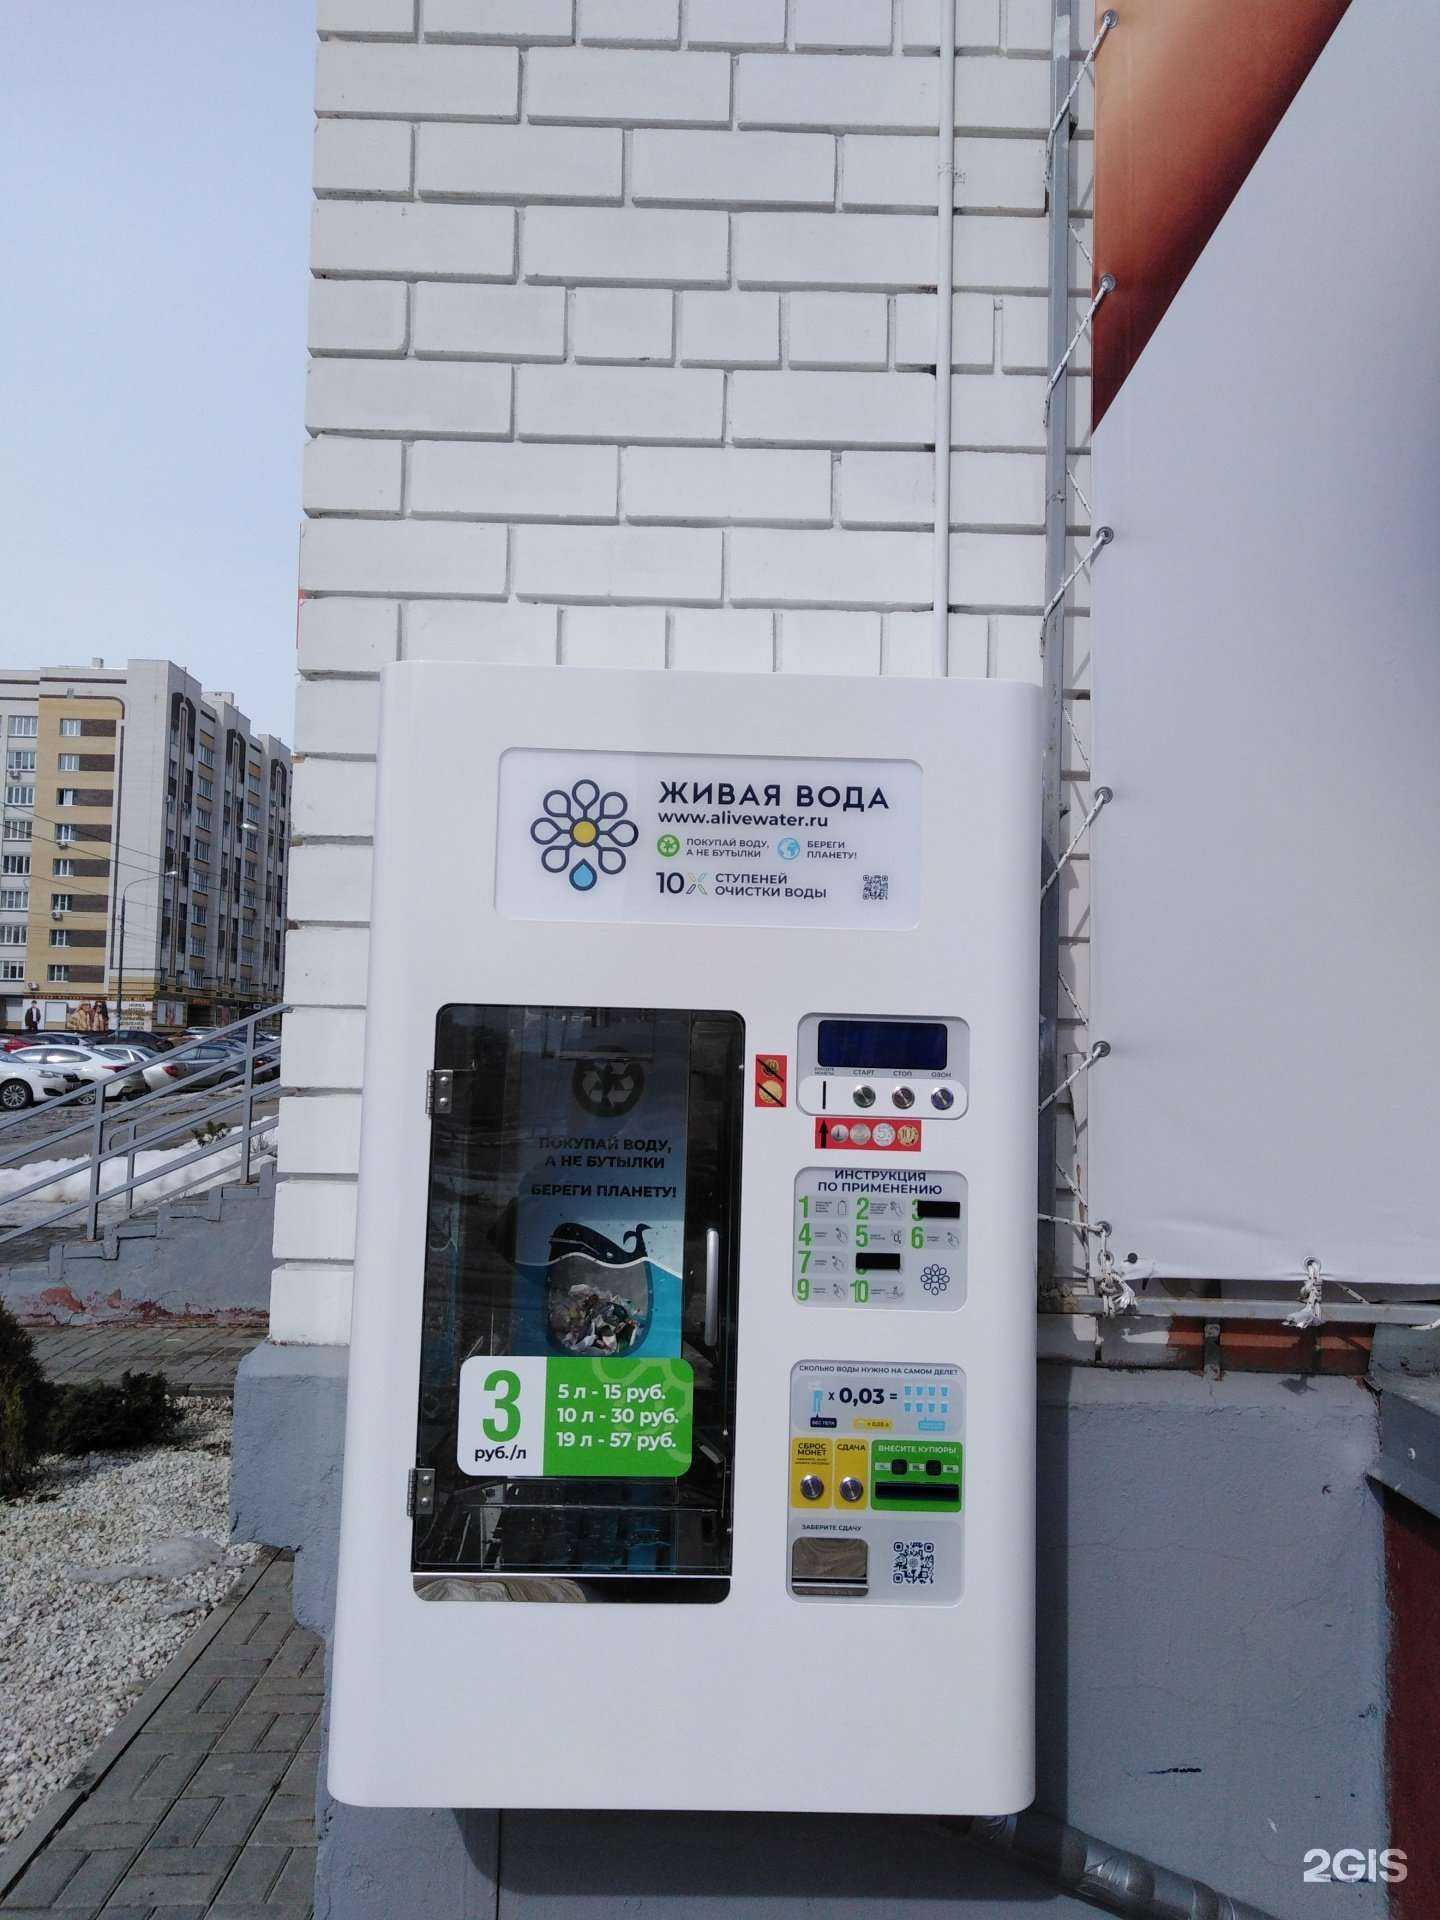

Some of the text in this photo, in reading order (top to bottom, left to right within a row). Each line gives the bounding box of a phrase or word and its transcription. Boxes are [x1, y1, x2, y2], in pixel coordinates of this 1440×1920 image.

[658, 781, 889, 812] ЖИВАЯ ВОДА
[658, 810, 828, 827] www.alivewater.ru
[686, 837, 770, 849] ПОКУПАЙ ВОДУ,
[807, 840, 845, 849] БЕРЕГИ
[696, 849, 710, 857] НЕ
[712, 849, 761, 858] БУТЫЛКИ
[806, 851, 857, 860] ПЛАНЕТУ!
[715, 872, 787, 884] СТУПЕНЕЙ
[715, 886, 826, 899] ОЧИСТКИ ВОДЫ
[538, 1136, 672, 1153] ПОКУПАЙ ВОДУ,
[545, 1155, 664, 1168] А НЕ БУТЫЛКИ
[834, 1170, 926, 1182] ИНСТРУКЦИЯ
[531, 1184, 676, 1198] БЕРЕГИ ПЛАНЕТУ!
[818, 1182, 942, 1195] ПО ПРИМЕНЕНИЮ
[799, 1195, 809, 1218] 1
[856, 1197, 869, 1220] 2
[799, 1223, 812, 1246] 4
[856, 1225, 868, 1247] 5
[911, 1226, 924, 1249] 6
[798, 1250, 811, 1274] 7
[797, 1279, 810, 1301] 9
[850, 1280, 869, 1303] 10
[558, 1384, 569, 1399] 5
[573, 1387, 586, 1399] л
[603, 1384, 621, 1399] 15
[627, 1384, 666, 1403] руб.
[839, 1387, 885, 1407] 0,03
[482, 1369, 521, 1442] 3
[557, 1408, 576, 1423] 10
[581, 1411, 594, 1423] л
[610, 1408, 634, 1424] 30
[640, 1408, 679, 1427] руб.
[556, 1432, 575, 1447] 19
[579, 1435, 592, 1447] л
[609, 1432, 632, 1448] 57
[637, 1432, 677, 1451] руб.
[798, 1442, 826, 1450] СБРОС
[837, 1443, 866, 1451] СДАЧА
[878, 1445, 957, 1454] ВНЕСИТЕ КУПЮРЫ
[474, 1445, 527, 1462] руб./л
